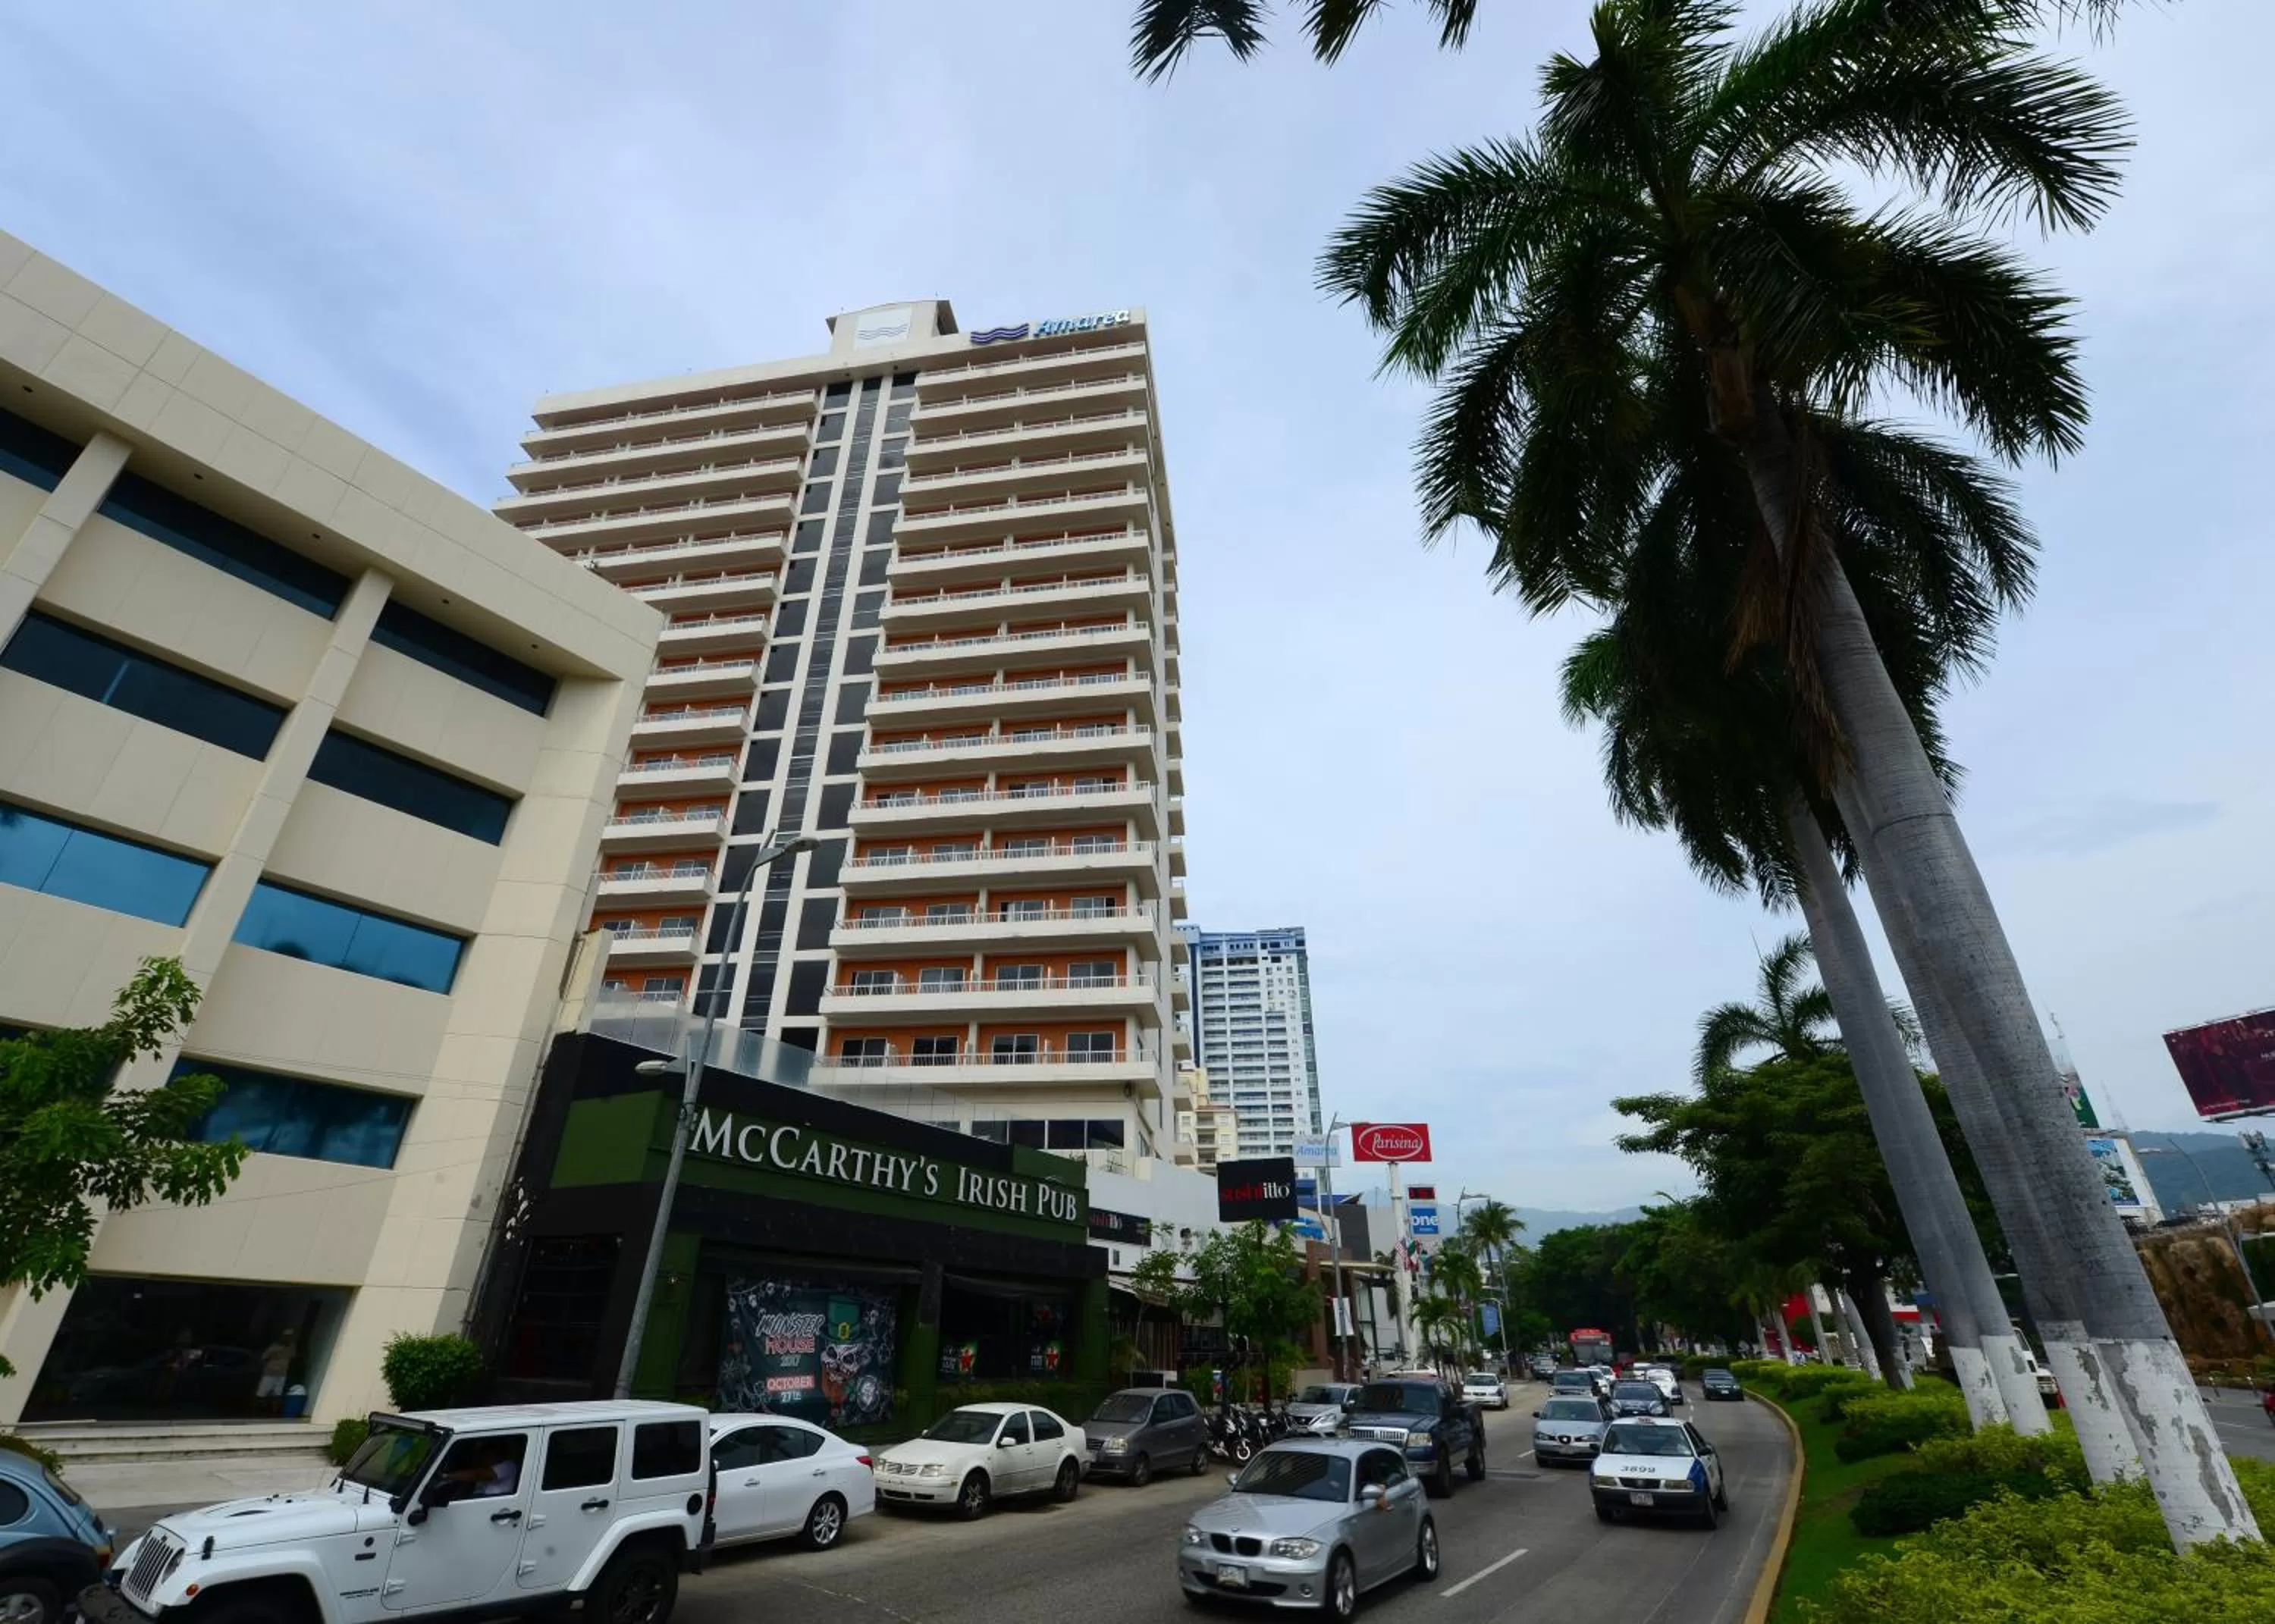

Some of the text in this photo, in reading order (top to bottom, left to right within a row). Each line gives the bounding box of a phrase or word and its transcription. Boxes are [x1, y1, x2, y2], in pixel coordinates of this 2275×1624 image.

[1034, 309, 1129, 337] Amarea
[1373, 1132, 1421, 1149] Parisina
[1413, 1215, 1439, 1226] one
[767, 1375, 814, 1390] OCTOBER
